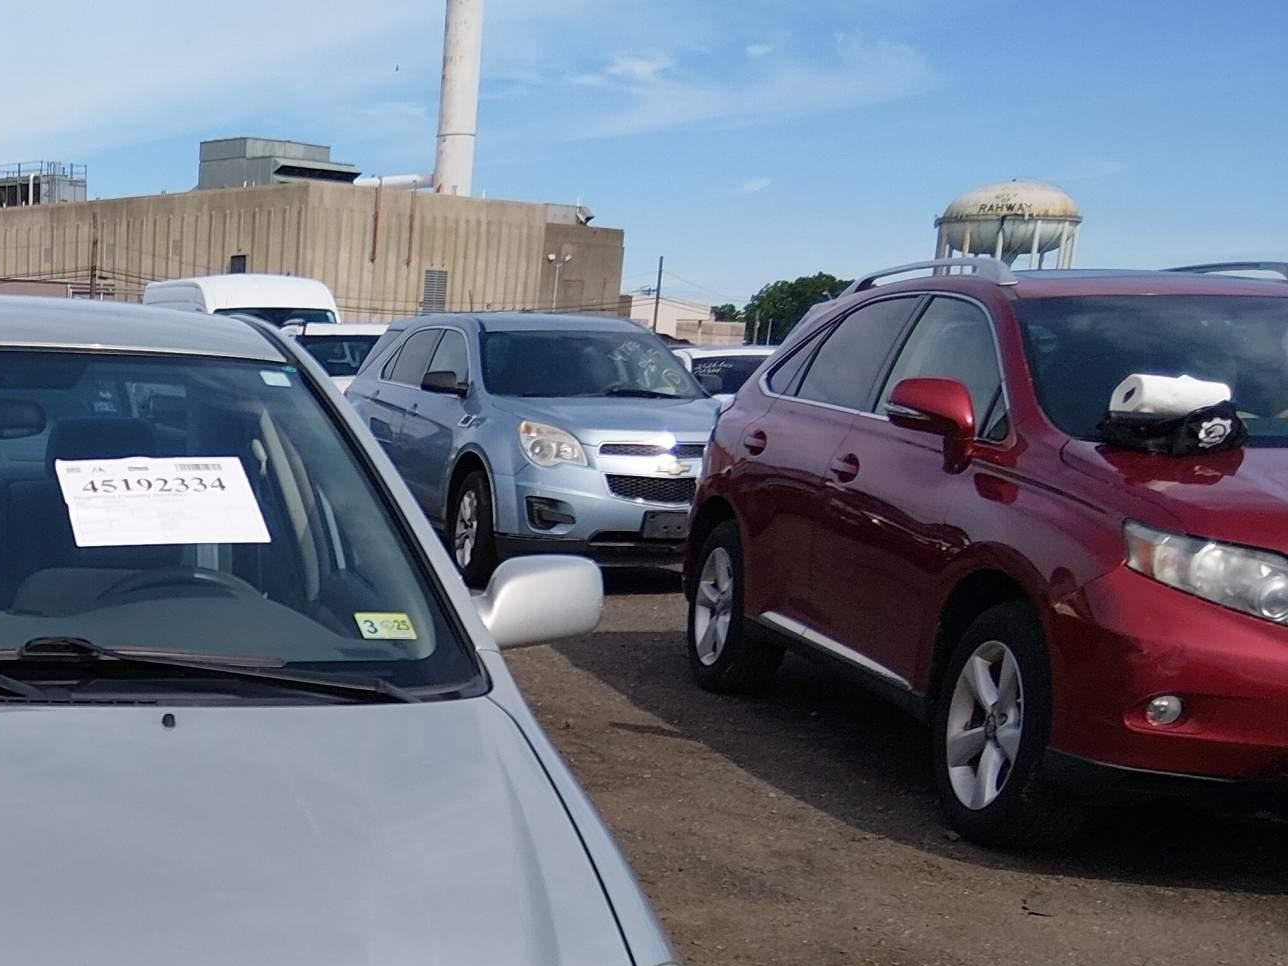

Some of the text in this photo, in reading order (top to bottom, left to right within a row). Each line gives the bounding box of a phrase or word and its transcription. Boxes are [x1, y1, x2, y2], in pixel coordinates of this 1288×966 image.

[978, 202, 1032, 213] RAHWAY
[82, 476, 226, 494] 45192334
[362, 619, 379, 635] 3
